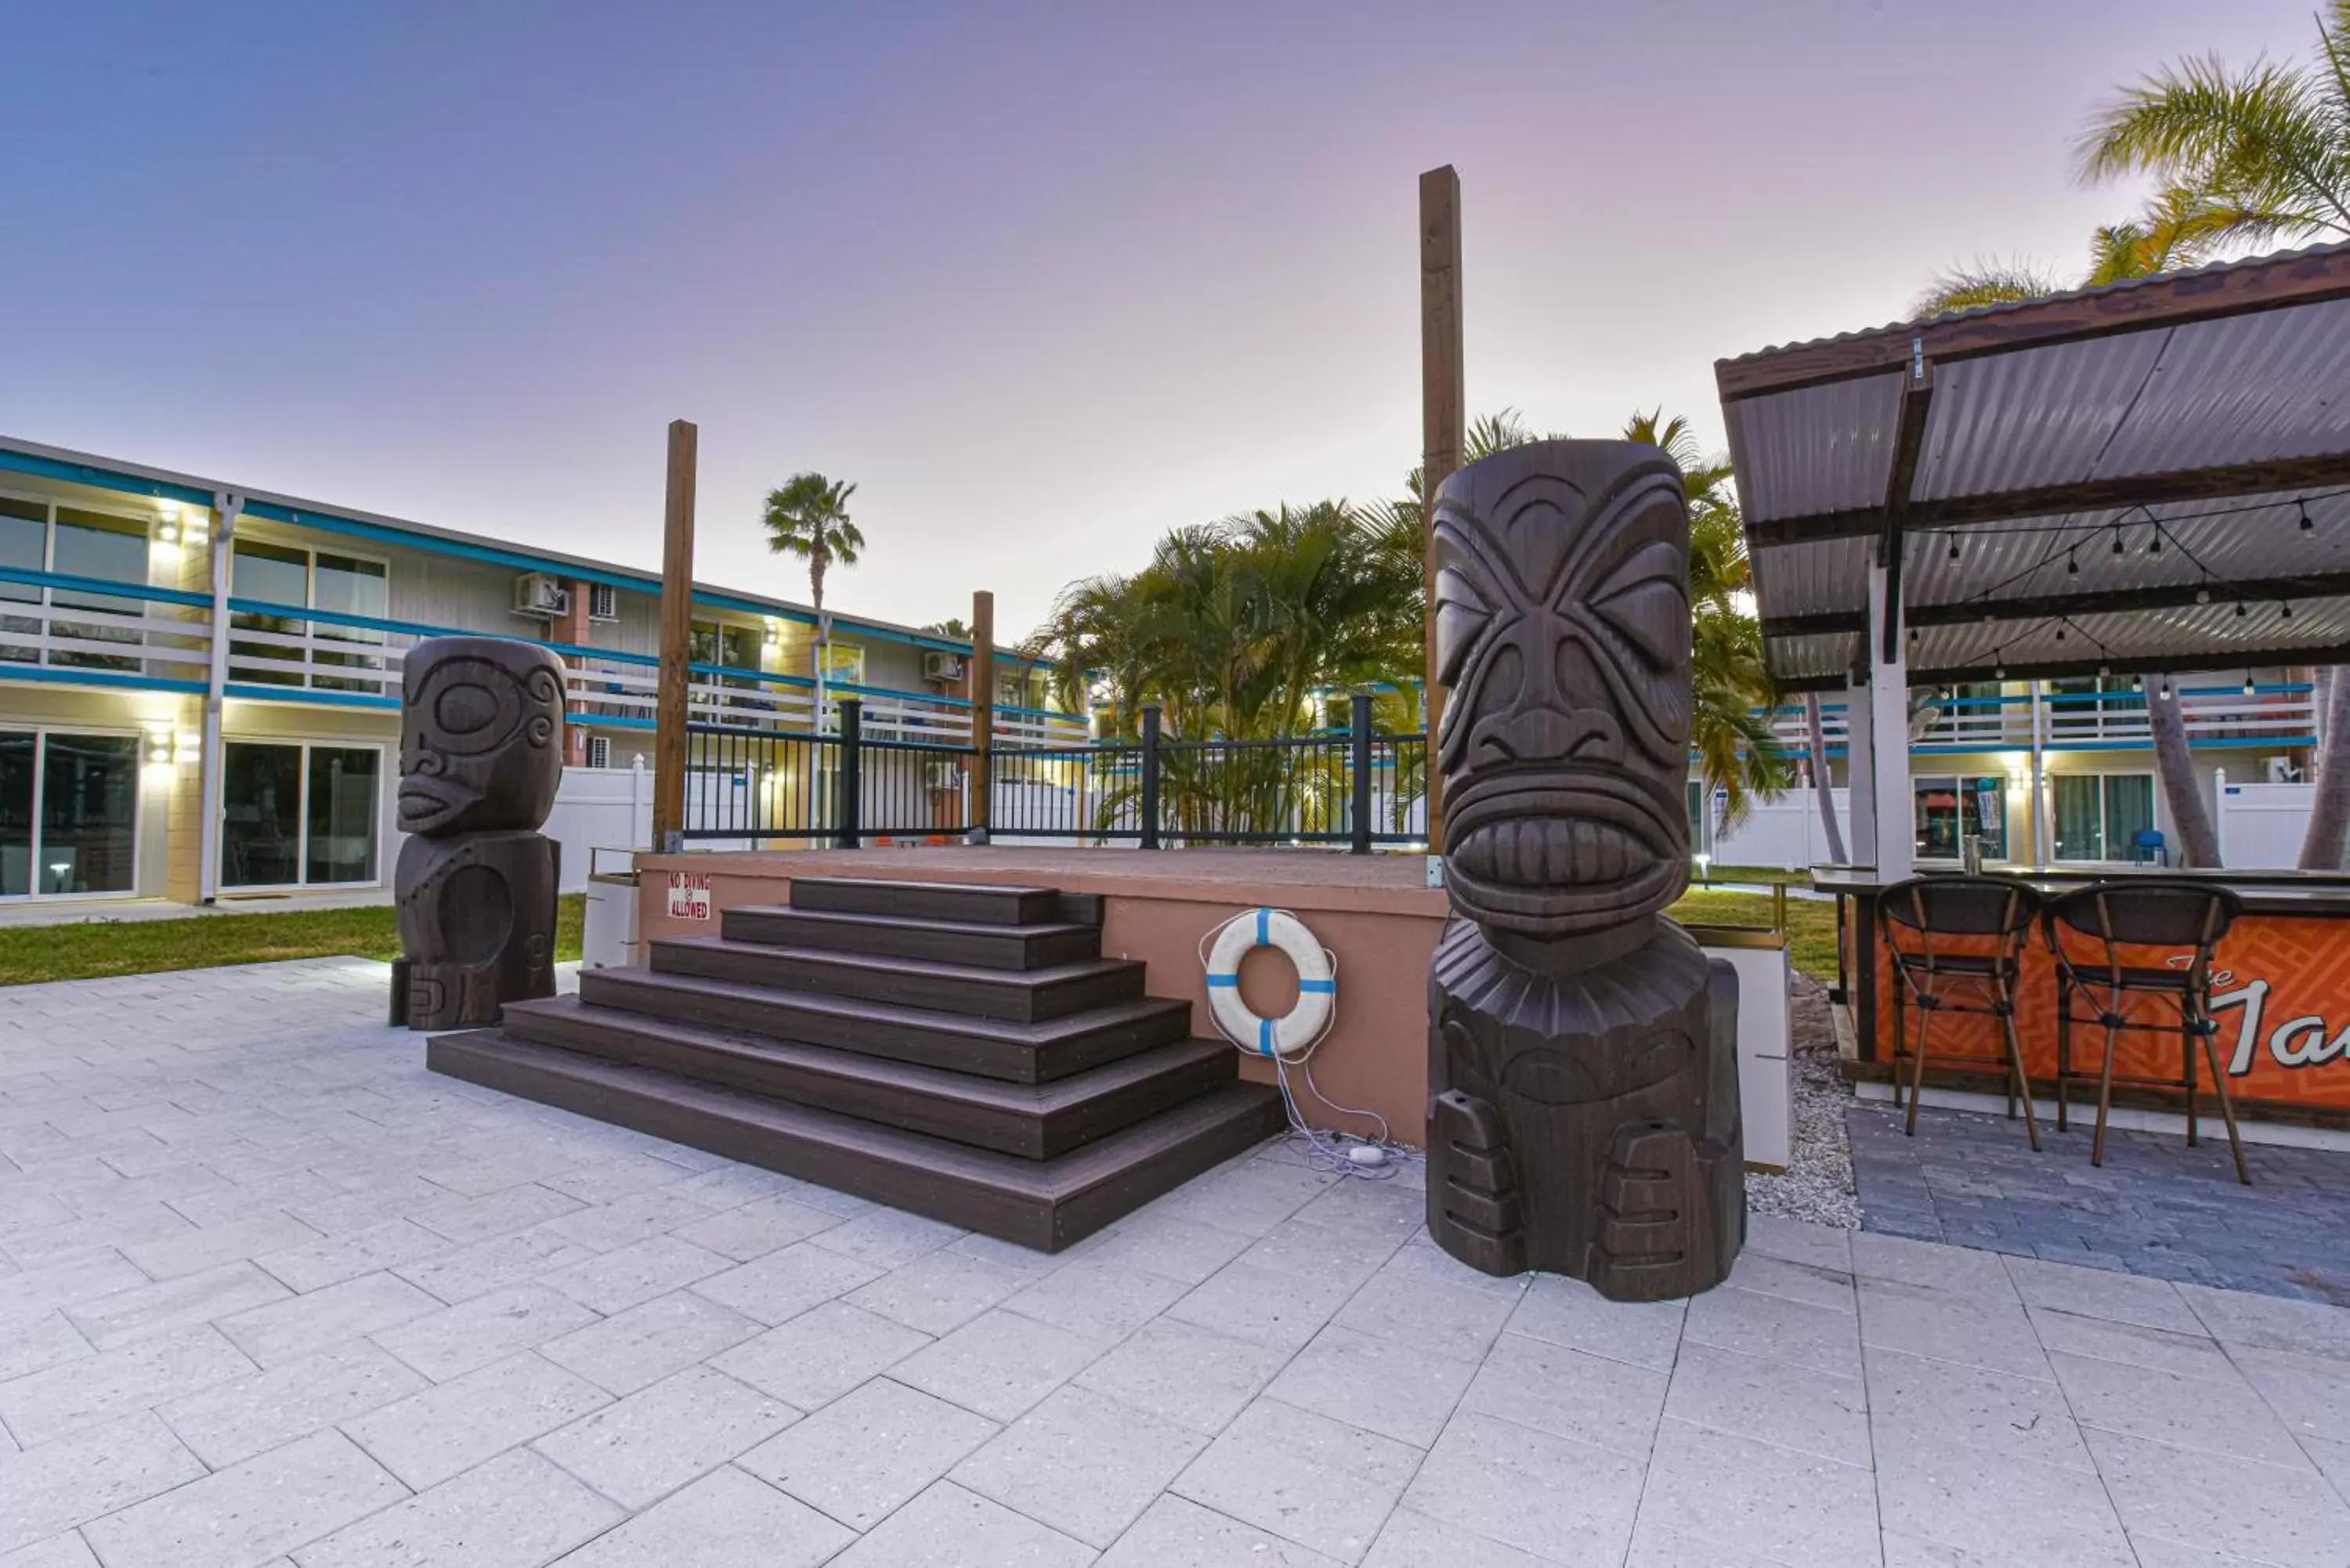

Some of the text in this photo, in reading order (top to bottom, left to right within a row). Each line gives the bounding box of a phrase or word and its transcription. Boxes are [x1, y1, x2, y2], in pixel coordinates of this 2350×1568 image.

[669, 872, 711, 891] NO DIVING
[671, 901, 707, 919] ALLOWED
[2166, 954, 2234, 987] Te
[2194, 978, 2350, 1077] Ta
